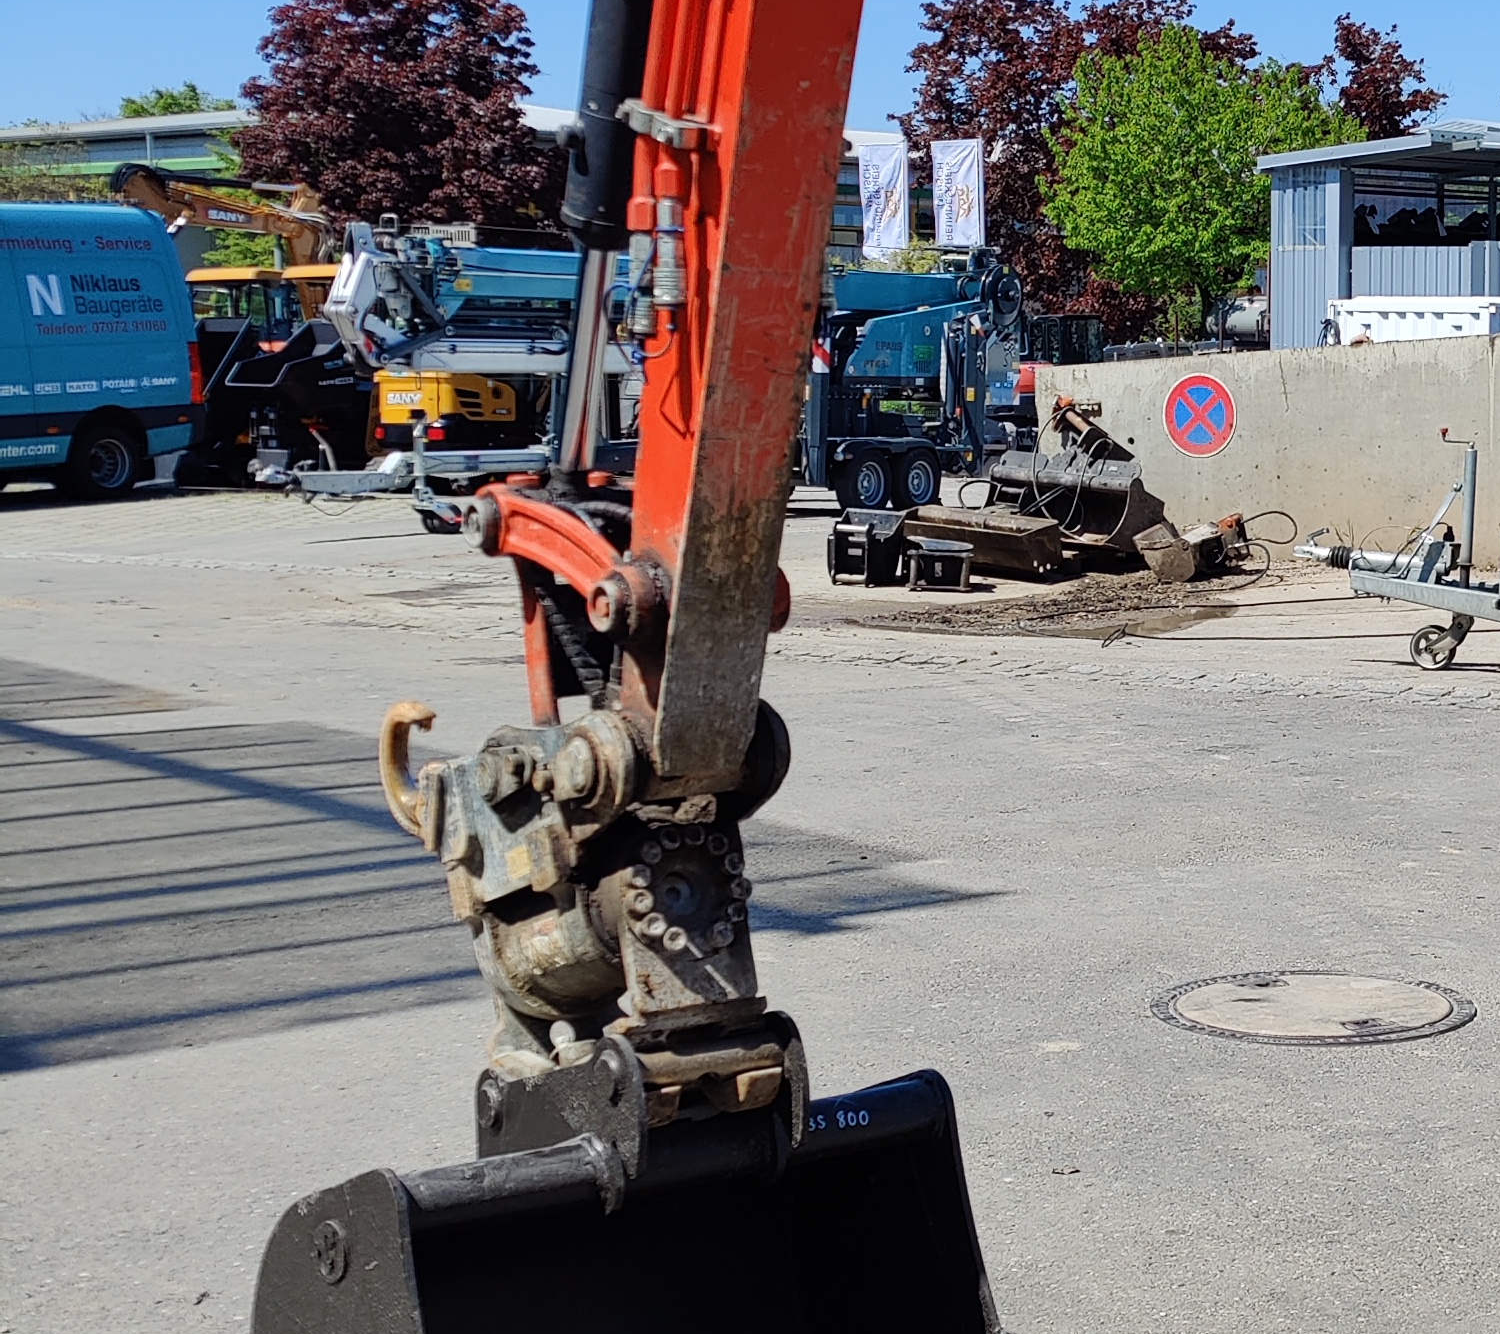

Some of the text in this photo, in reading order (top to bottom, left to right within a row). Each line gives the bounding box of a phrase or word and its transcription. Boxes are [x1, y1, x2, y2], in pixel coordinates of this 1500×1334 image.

[207, 208, 247, 223] SANY
[95, 236, 151, 251] Service
[70, 274, 141, 293] Niklaus
[26, 274, 66, 316] N
[74, 295, 164, 318] Baugeräte
[37, 323, 87, 336] Telefon:
[35, 384, 60, 394] JCB
[68, 383, 95, 391] KATO
[152, 377, 178, 386] SANY
[386, 393, 423, 405] SANY
[0, 444, 57, 458] nter.com
[836, 1110, 869, 1129] 800
